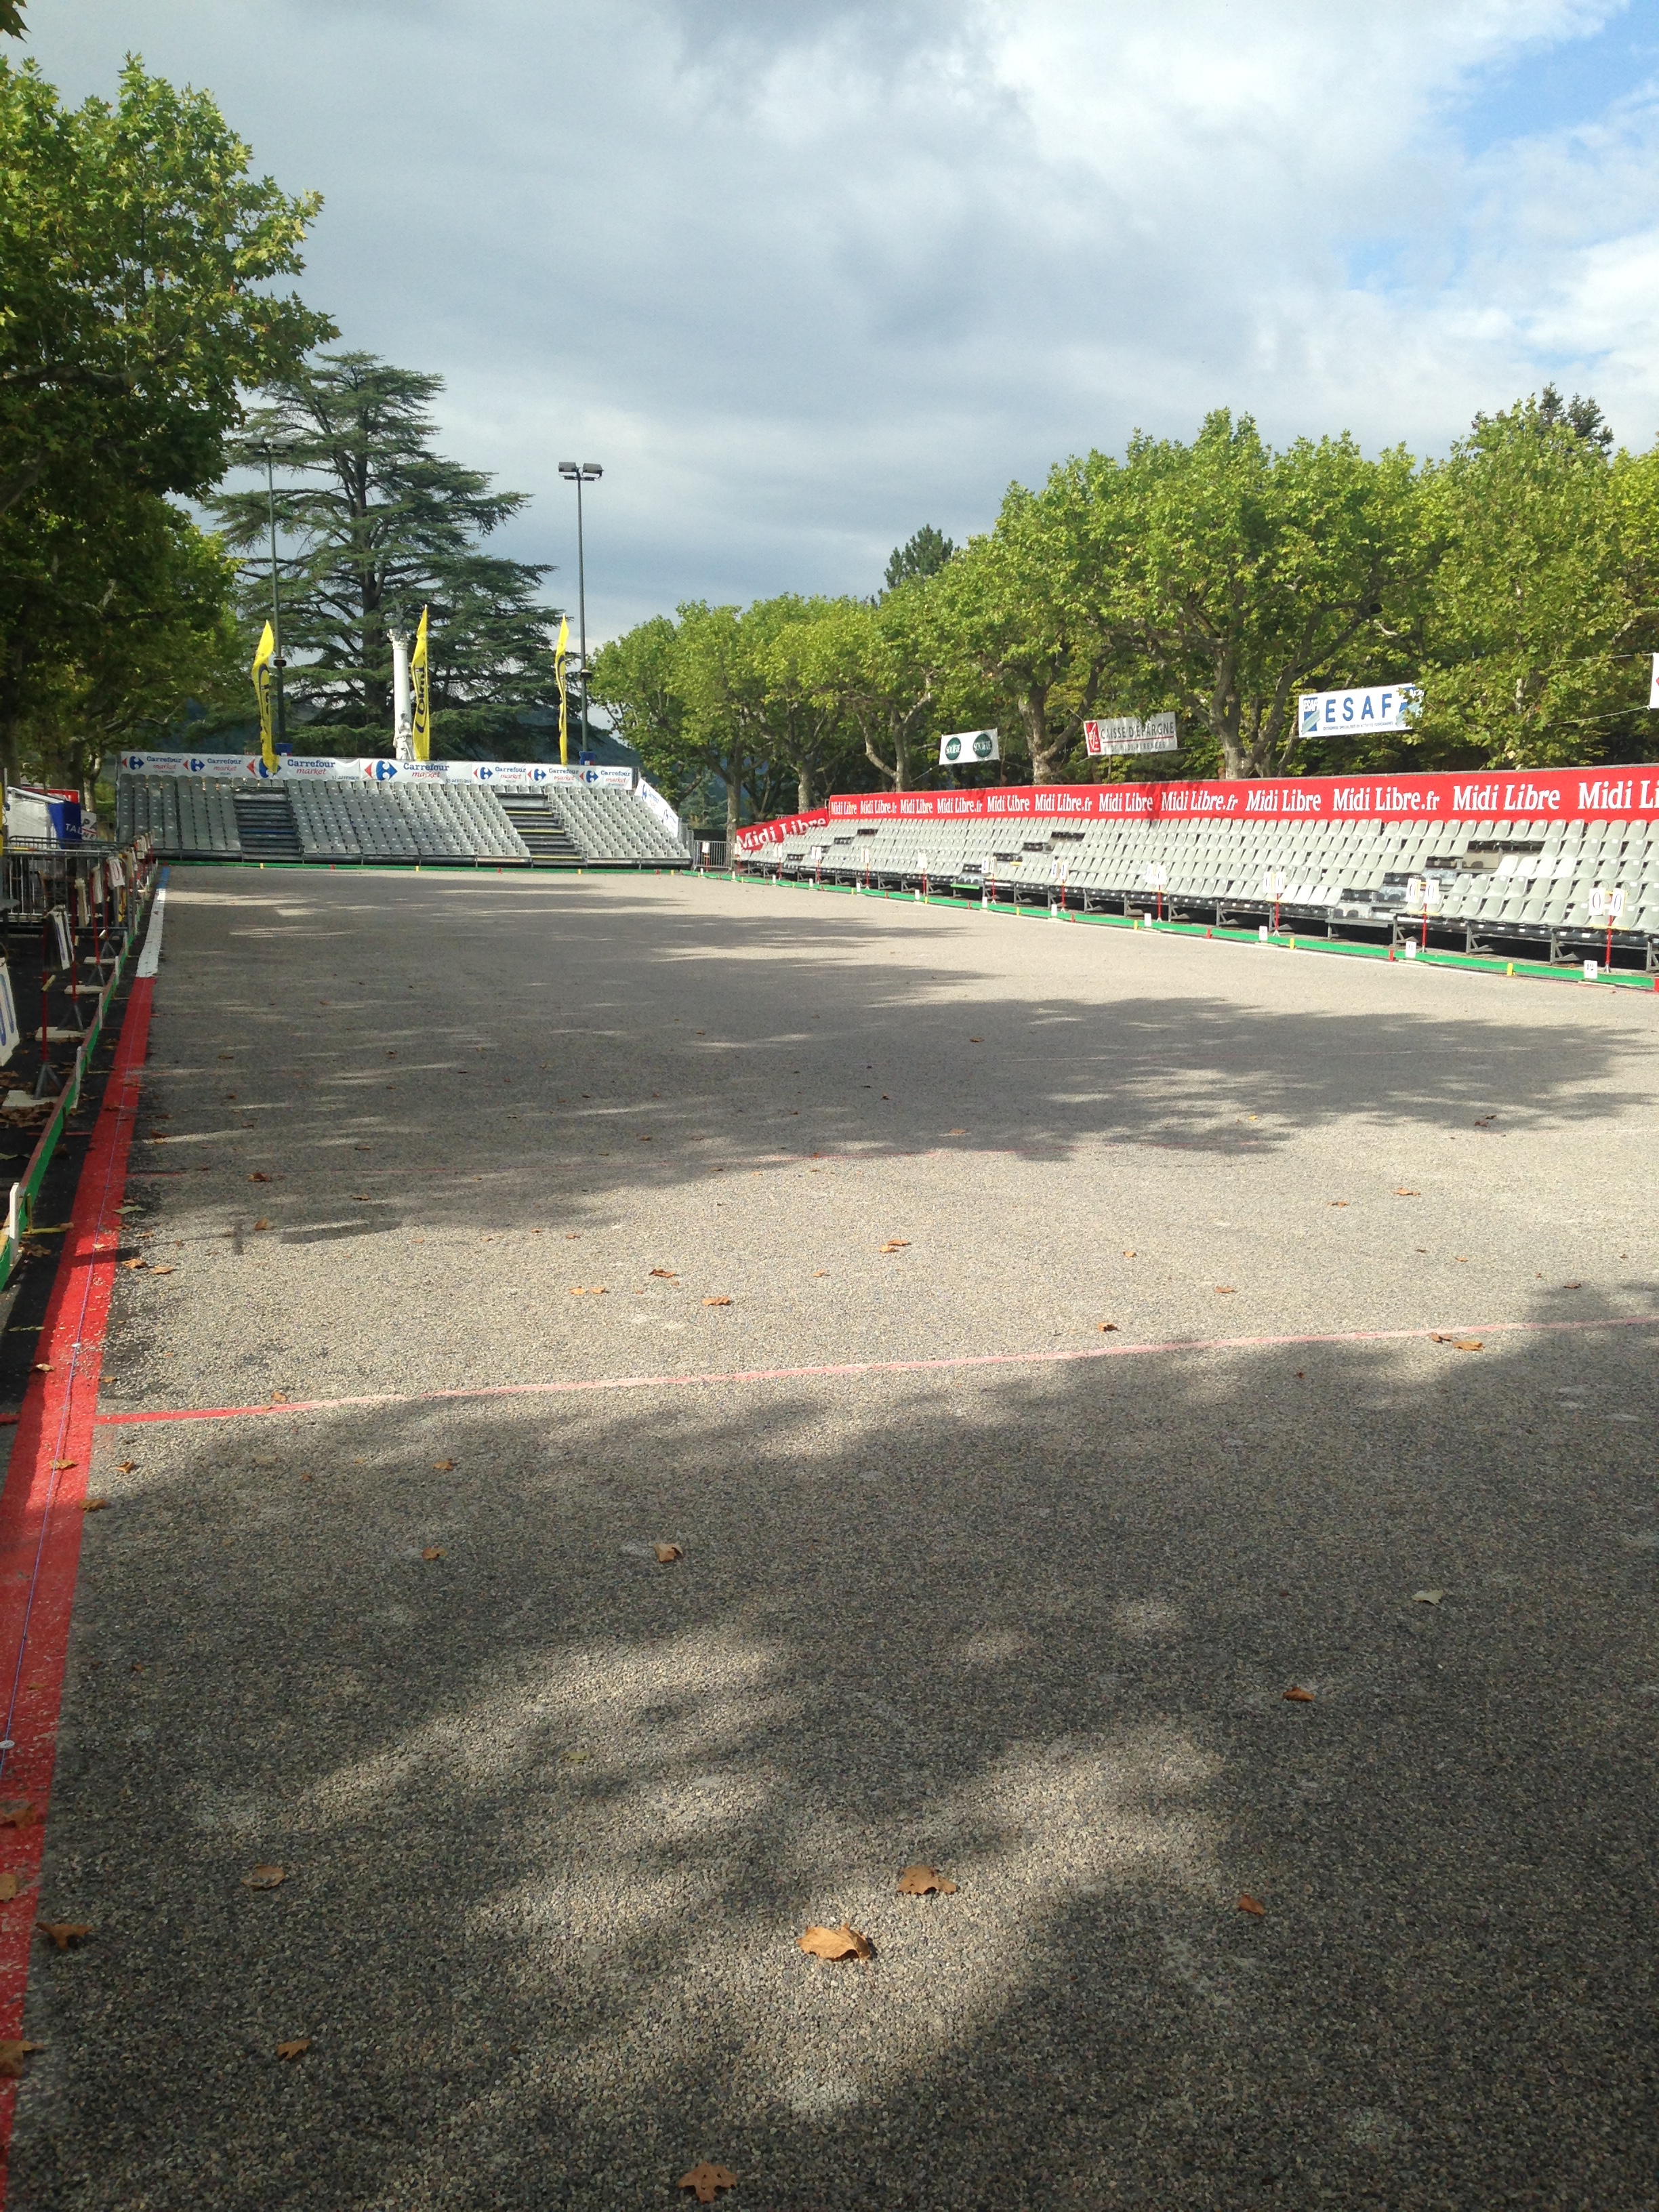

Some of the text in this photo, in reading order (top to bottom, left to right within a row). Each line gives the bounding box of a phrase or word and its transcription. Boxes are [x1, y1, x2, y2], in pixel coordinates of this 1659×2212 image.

[1326, 693, 1392, 722] ESAF
[1101, 726, 1125, 739] CAISSE
[287, 759, 335, 768] Carrefour
[403, 763, 449, 771] Carrefour
[1035, 794, 1092, 811] Midi Libre.fr
[1099, 792, 1153, 812] Midi Libre
[1161, 790, 1238, 811] Midi Libre.fr
[1246, 789, 1322, 811] Midi Libre
[1332, 786, 1440, 811] Midi Libre.fr
[1452, 783, 1560, 811] Midi Libre
[1577, 780, 1633, 809] Midi
[831, 801, 857, 815] Midi Libre
[860, 800, 897, 814] Midi Libre.fr
[901, 799, 933, 814] Midi Libre
[937, 798, 983, 813] Midi Libre.fr
[987, 795, 1029, 813] Midi Libre
[737, 817, 827, 848] Midi Libre
[1593, 892, 1601, 910] 0
[1614, 893, 1622, 912] 0
